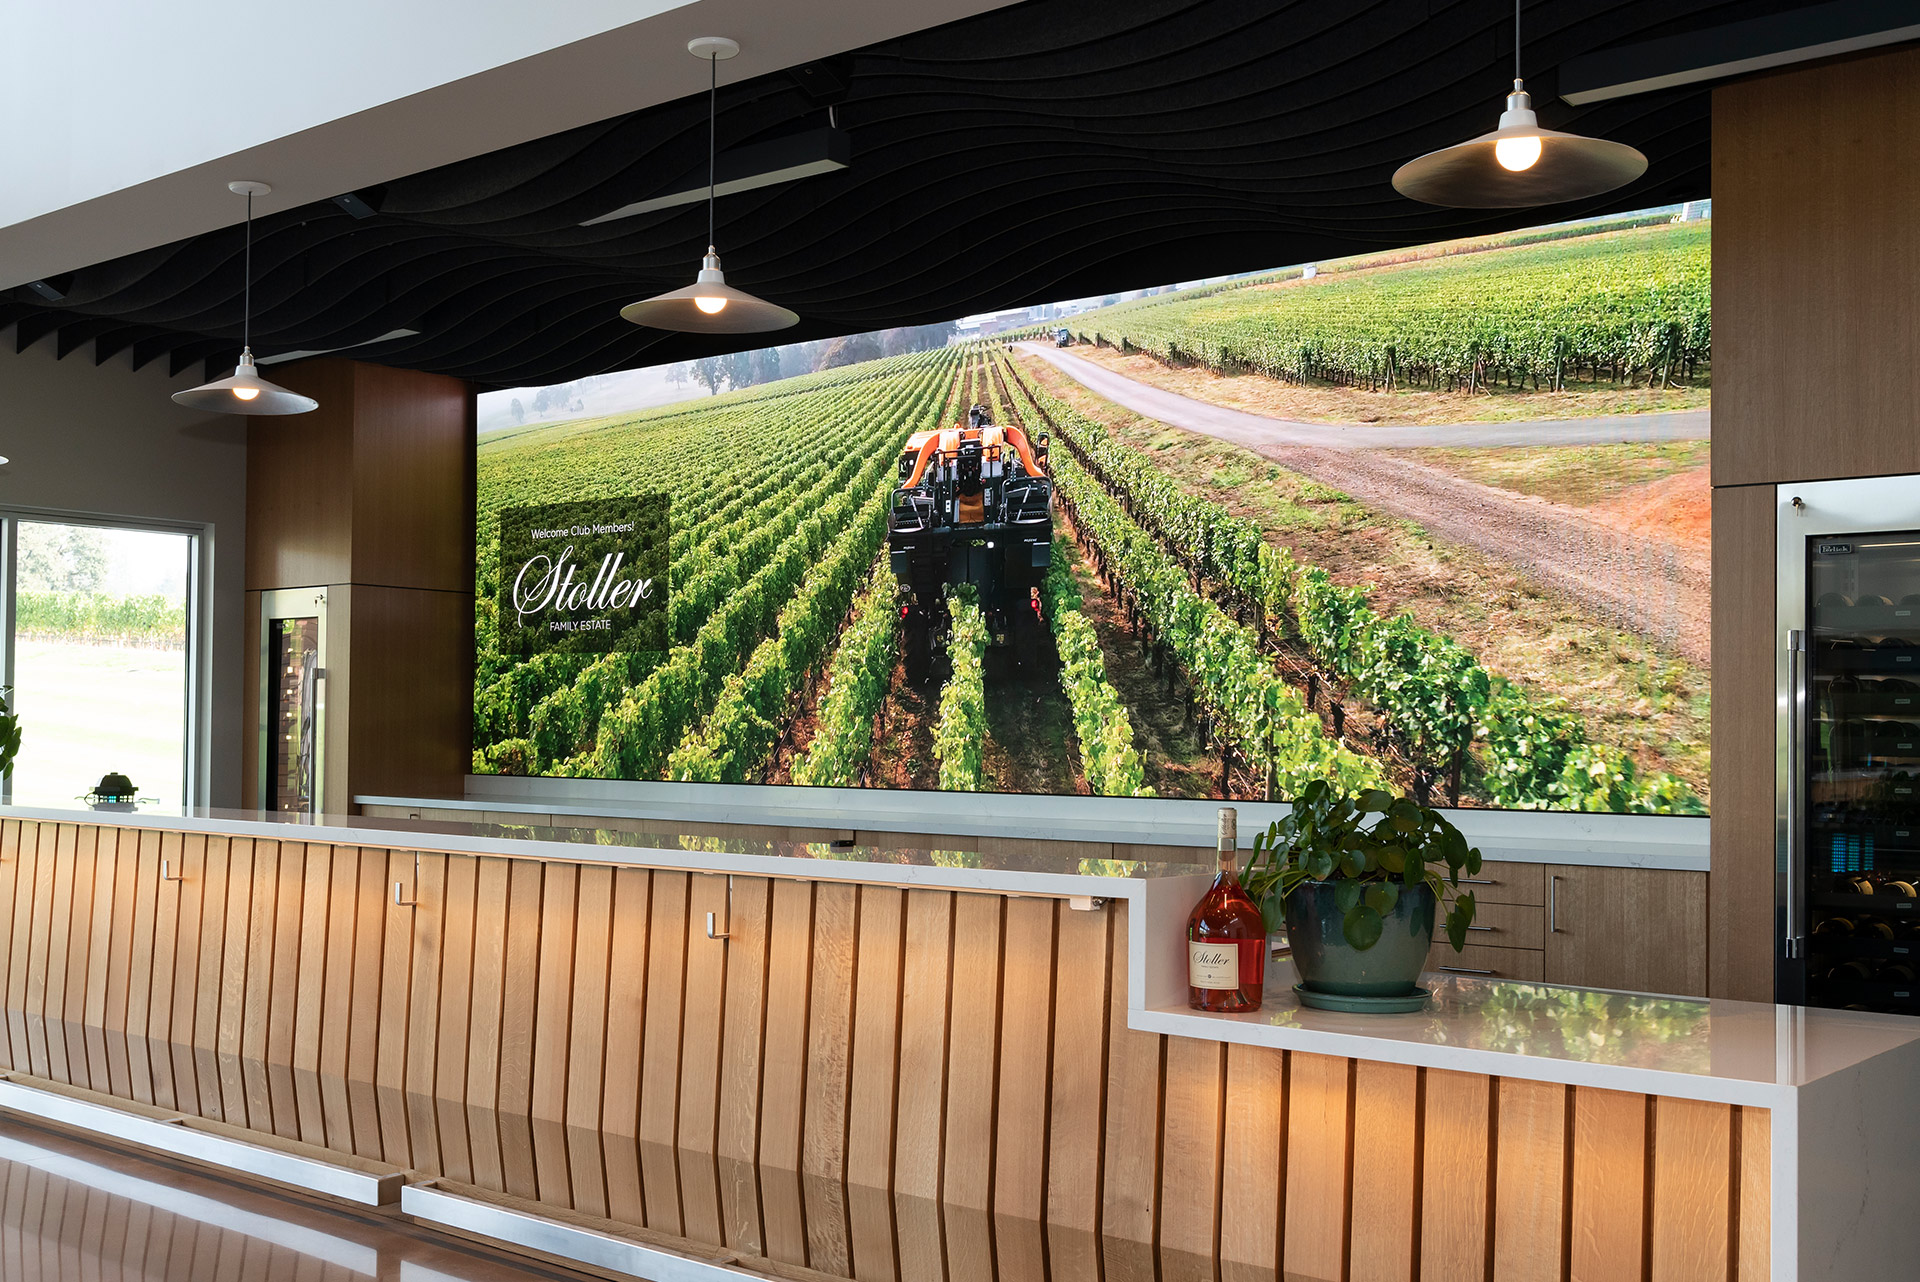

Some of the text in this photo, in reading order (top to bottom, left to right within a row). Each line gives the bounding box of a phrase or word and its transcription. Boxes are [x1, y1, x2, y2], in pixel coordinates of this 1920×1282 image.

[531, 521, 635, 539] Welcome Club Members!
[513, 545, 653, 628] Stoller
[550, 620, 611, 632] FAMILY ESTATE
[1193, 950, 1230, 965] Stoller
